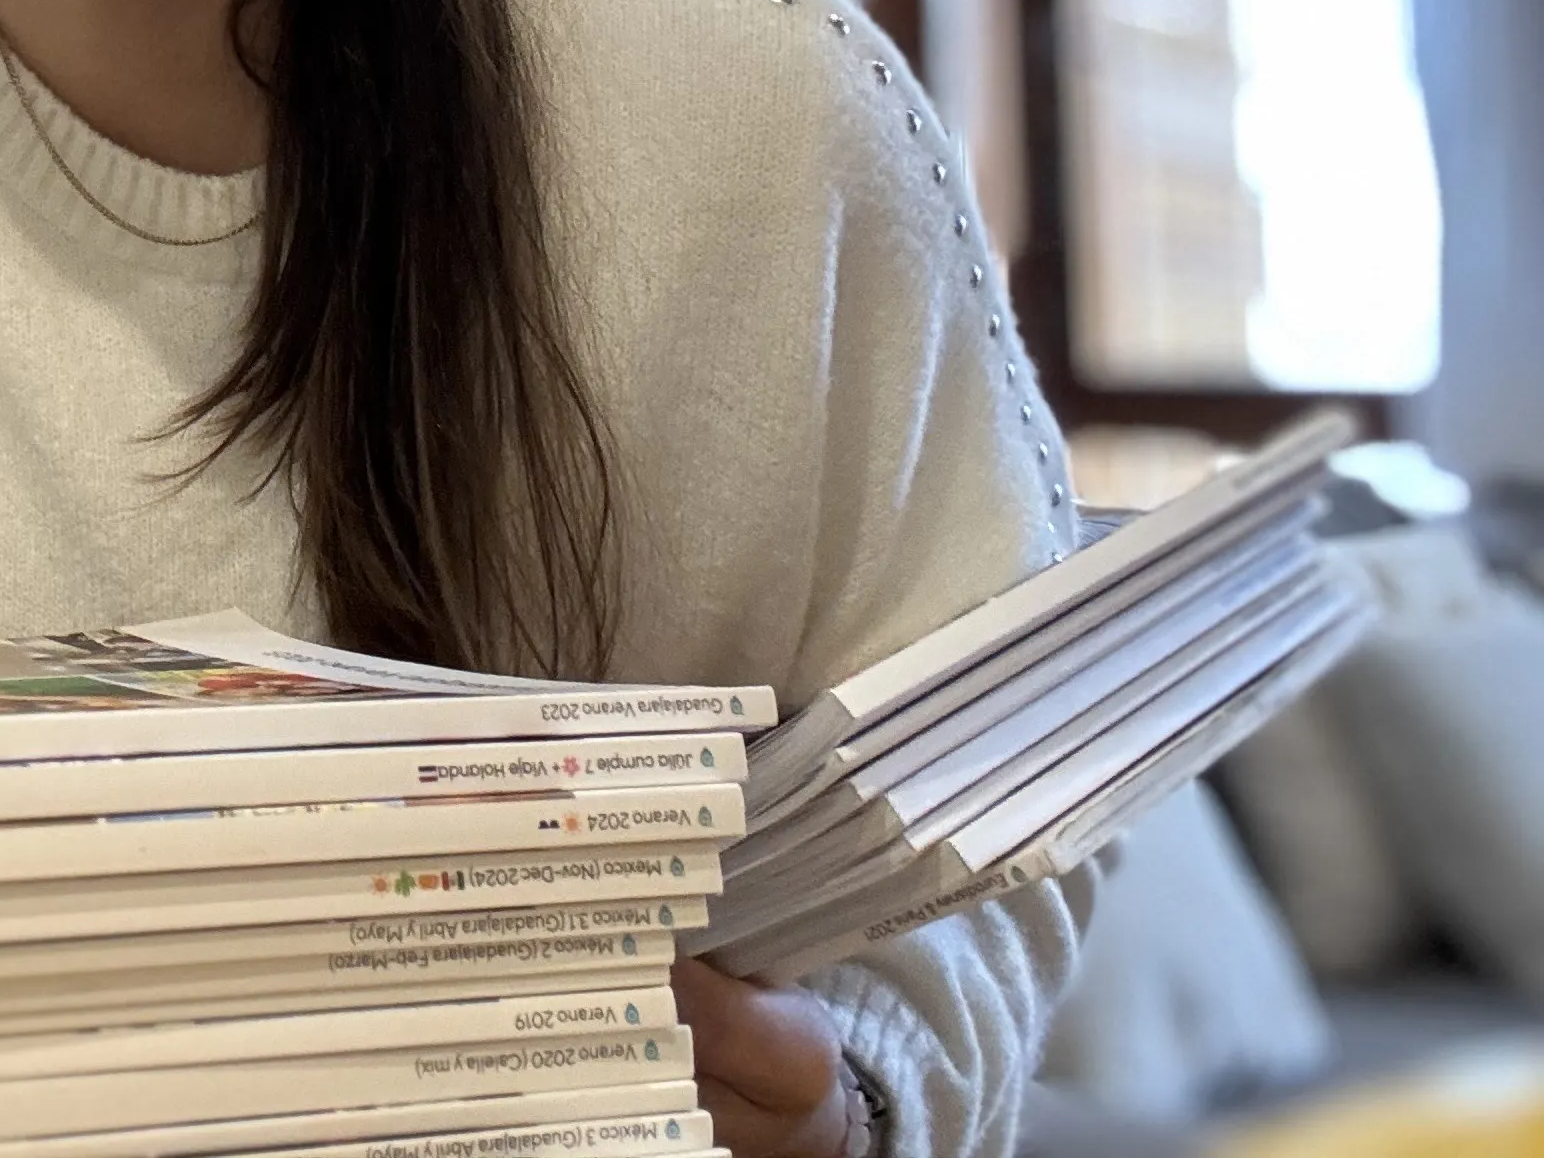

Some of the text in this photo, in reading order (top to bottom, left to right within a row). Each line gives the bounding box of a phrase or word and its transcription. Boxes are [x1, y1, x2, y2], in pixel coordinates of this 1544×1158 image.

[541, 696, 723, 721] Guadalajara Verano 2023
[437, 763, 505, 781] Holanda
[508, 757, 548, 777] Viaje
[595, 756, 654, 773] cumple
[587, 810, 691, 832] Verano 2024
[470, 866, 519, 888] 2024)
[519, 859, 600, 884] (Nov-Dec
[349, 922, 404, 947] Mayo)
[406, 919, 418, 937] y
[420, 921, 457, 940] Abril
[461, 913, 566, 937] (Guadalajara
[432, 941, 538, 965] (Guadalajara
[542, 942, 554, 957] 2
[328, 950, 430, 973] Feb-Marzo)
[514, 1008, 617, 1030] Verano 2019
[531, 1048, 576, 1069] 2020
[578, 1043, 637, 1061] Verano
[415, 1058, 453, 1078] mix)
[454, 1056, 466, 1072] y
[585, 1129, 597, 1143] 3
[599, 1121, 657, 1139] México
[436, 1137, 474, 1157] Abril
[478, 1129, 583, 1154] (Guadalajara
